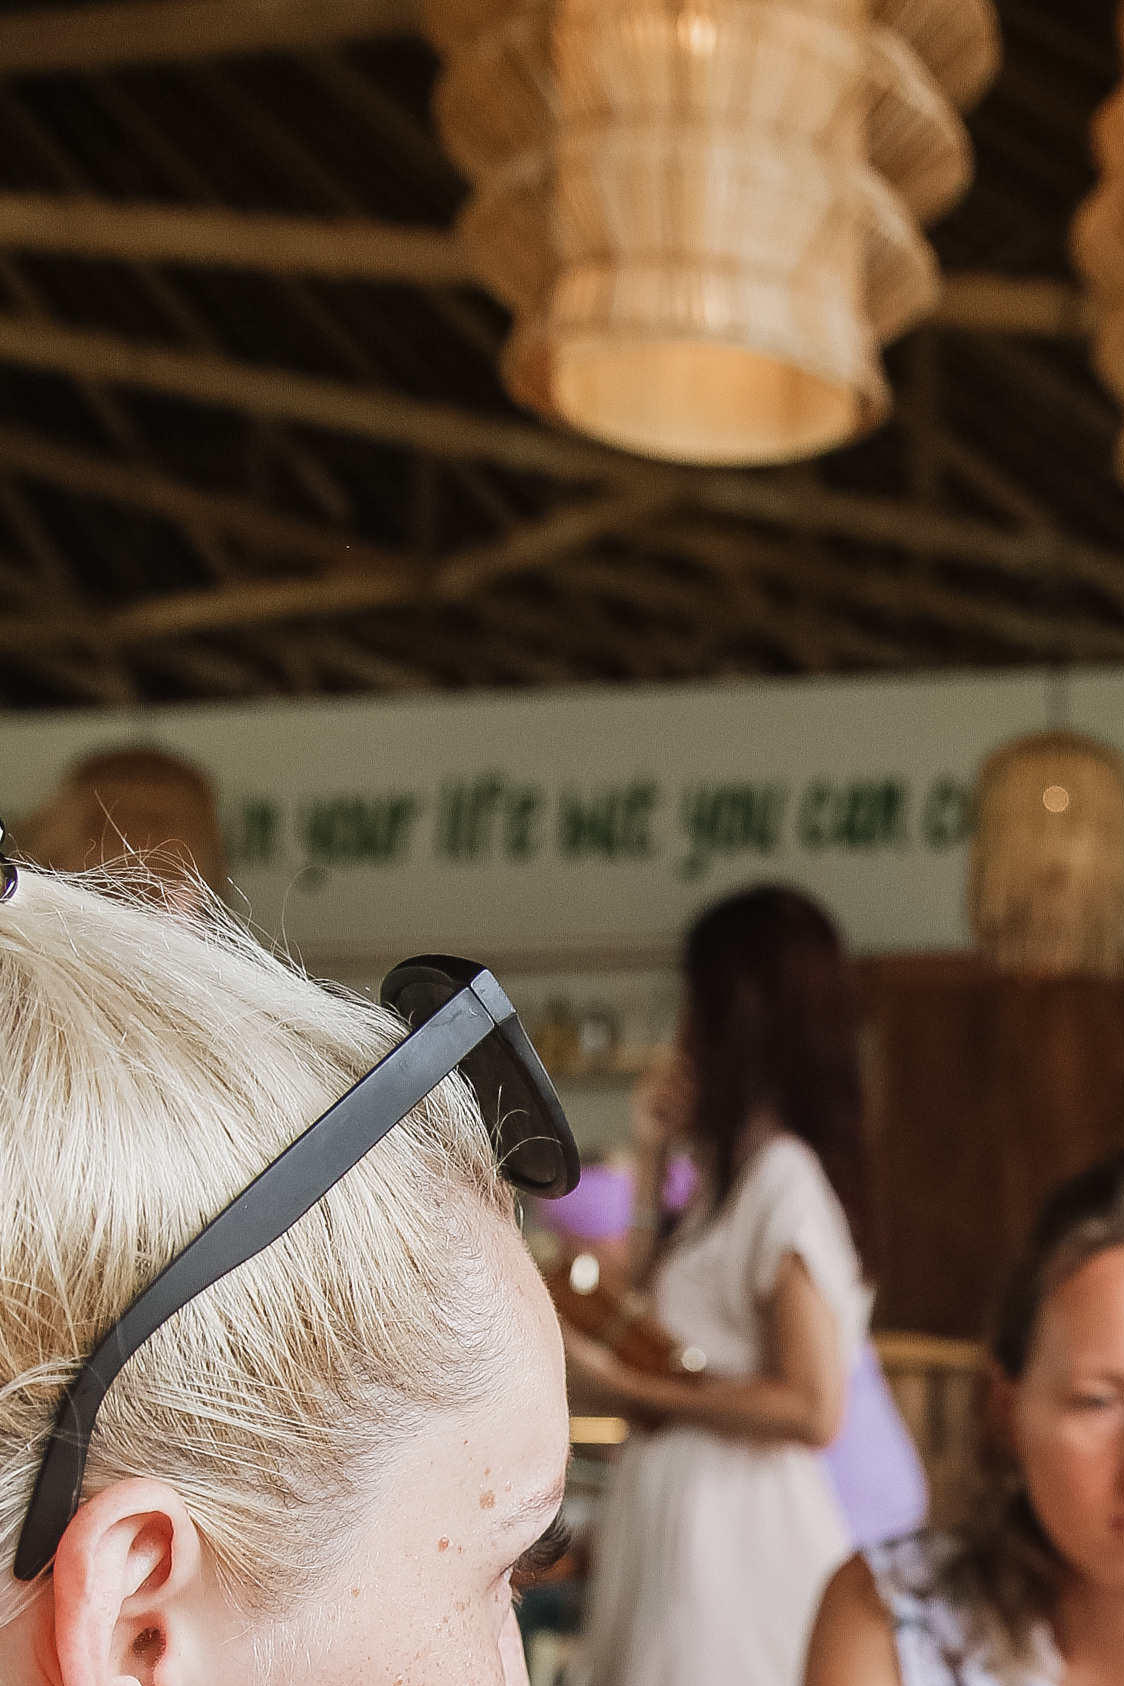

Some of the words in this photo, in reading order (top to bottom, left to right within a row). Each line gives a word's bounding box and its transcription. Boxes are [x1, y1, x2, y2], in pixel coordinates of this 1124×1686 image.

[302, 794, 412, 892] your
[440, 770, 542, 866] life
[680, 779, 780, 882] you
[800, 775, 906, 852] can
